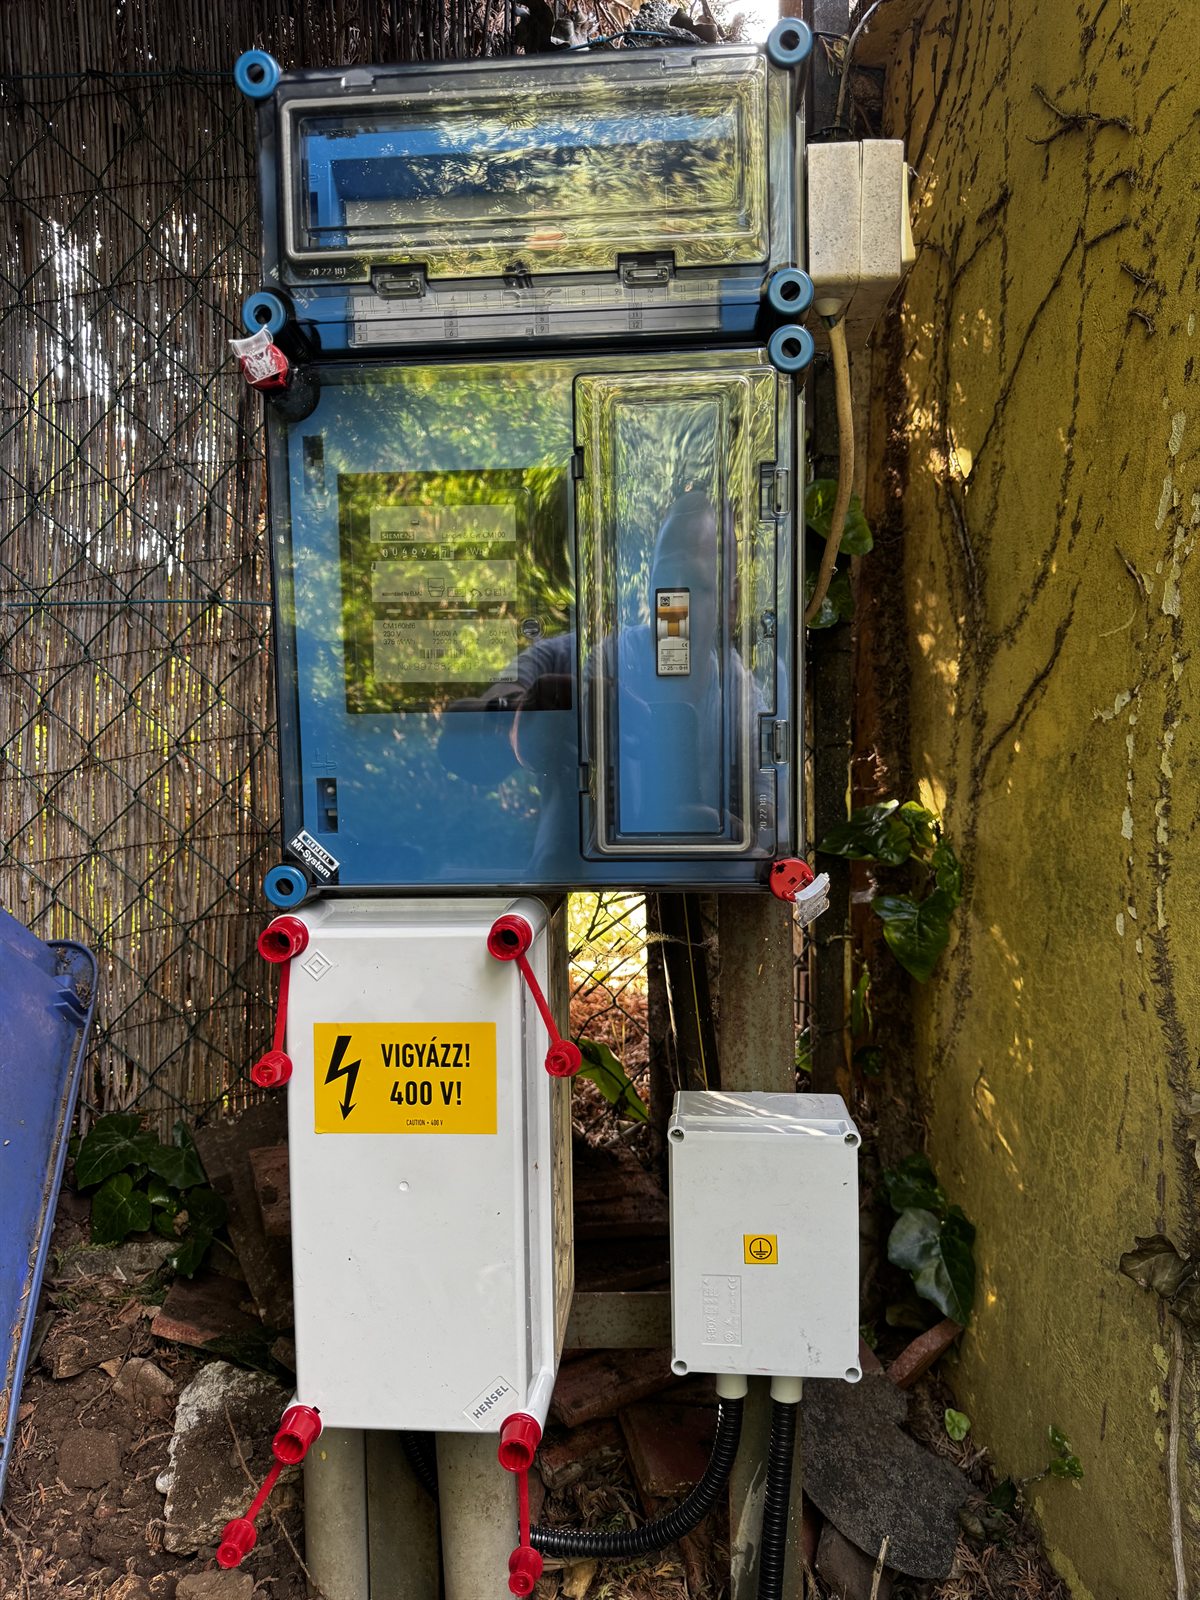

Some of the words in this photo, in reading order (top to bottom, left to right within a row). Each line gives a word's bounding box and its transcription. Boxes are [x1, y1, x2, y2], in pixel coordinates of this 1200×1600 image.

[381, 532, 415, 540] SIEMENS
[291, 838, 331, 878] Mi-System
[306, 839, 330, 863] HENSEL
[381, 1036, 470, 1068] VIGYÁZZ!
[390, 1081, 432, 1106] 400
[440, 1081, 462, 1106] V!
[472, 1385, 509, 1419] HENSEL
